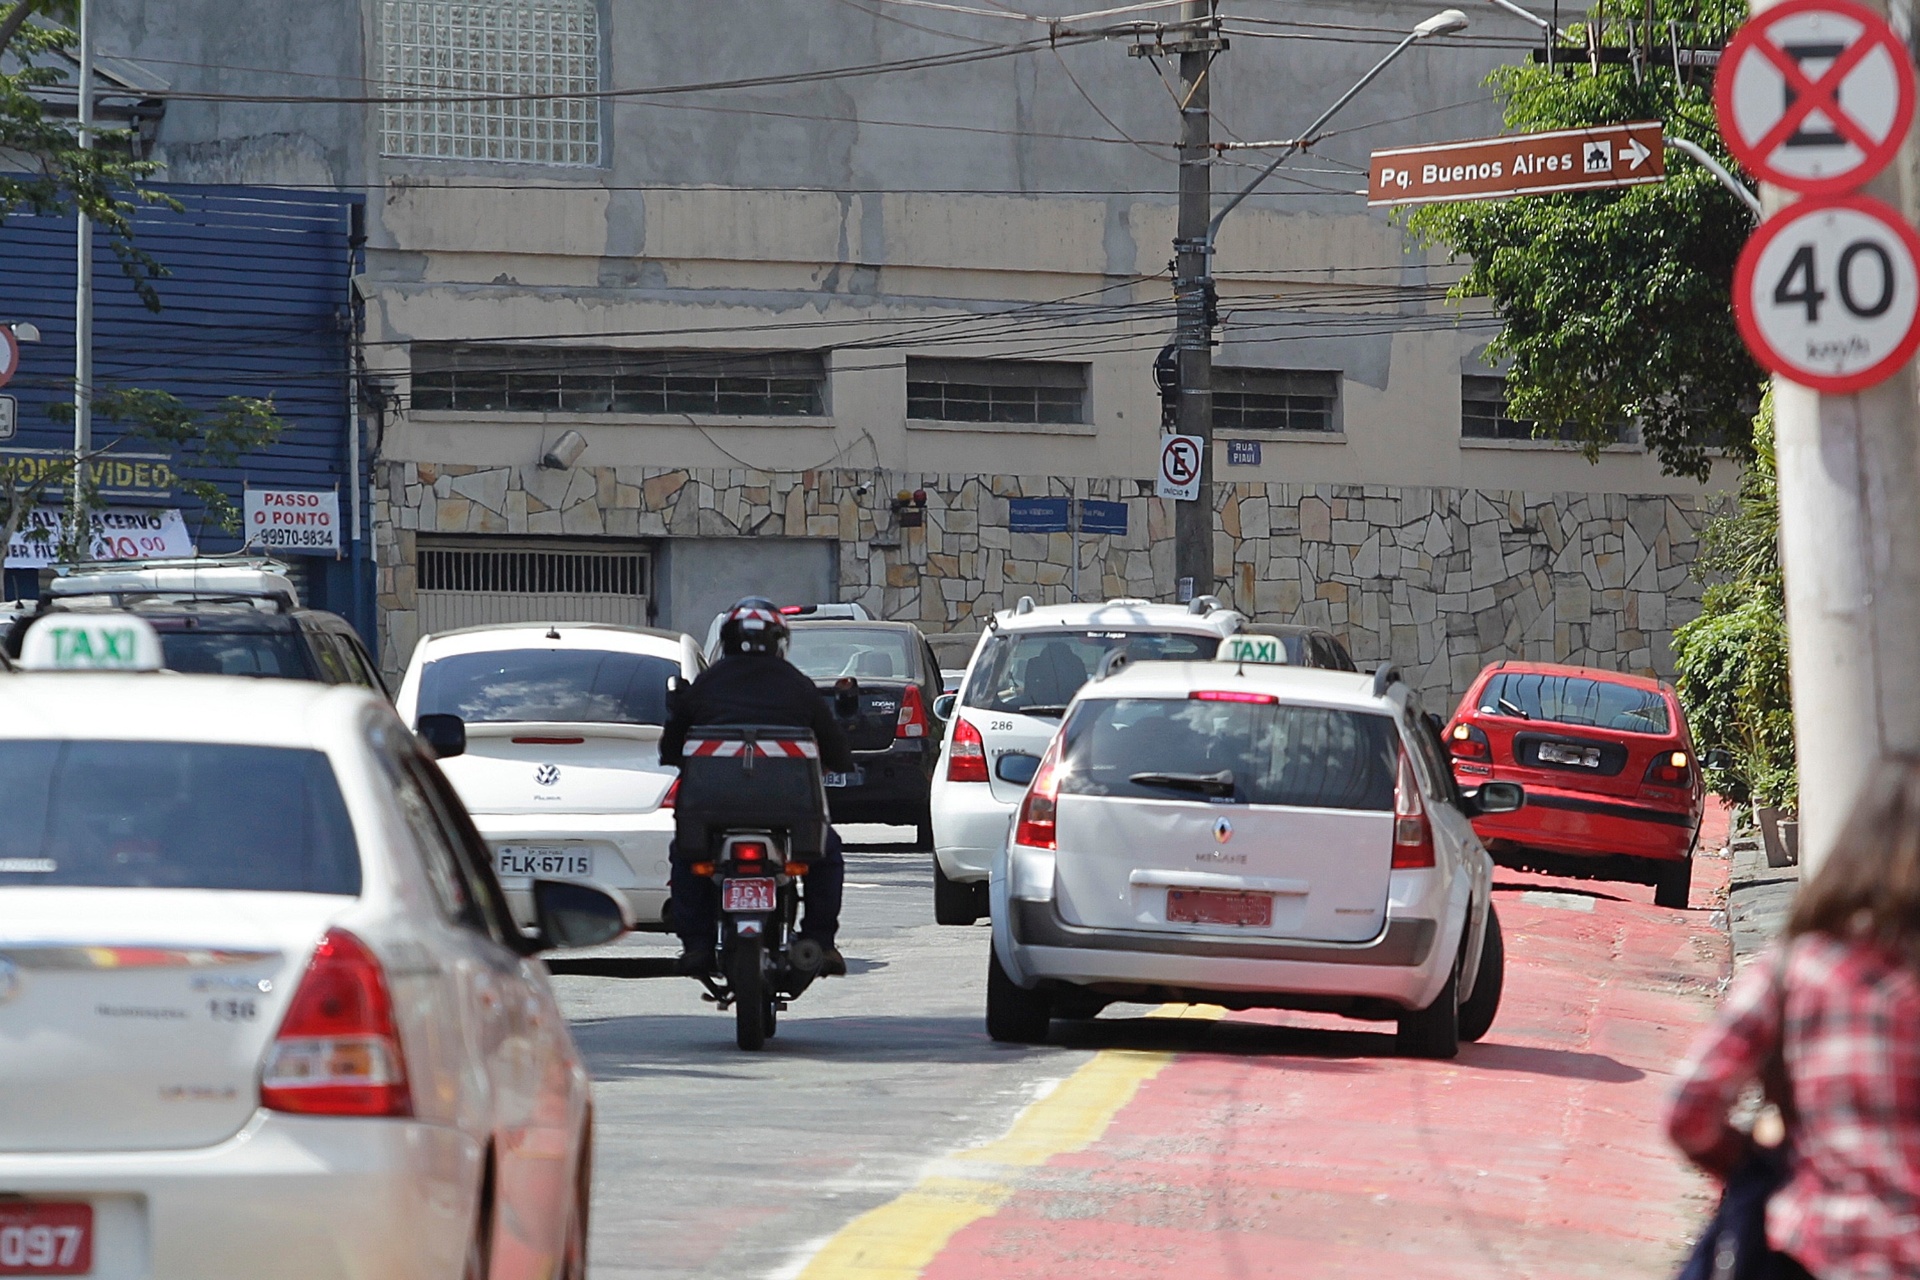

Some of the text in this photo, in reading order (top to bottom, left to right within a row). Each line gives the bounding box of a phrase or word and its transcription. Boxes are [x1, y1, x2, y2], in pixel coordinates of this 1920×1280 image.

[1380, 153, 1573, 190] Pq. Buenos Aires
[1774, 241, 1895, 322] 40
[1235, 443, 1254, 452] RUA
[89, 461, 172, 488] VIDEO
[263, 493, 319, 507] PASSO
[91, 512, 162, 531] ACERVO
[254, 511, 330, 526] O PONTO
[260, 528, 333, 546] 99970-9834
[48, 627, 137, 664] TAXI
[1230, 640, 1277, 662] TAXI
[991, 720, 1013, 731] 286
